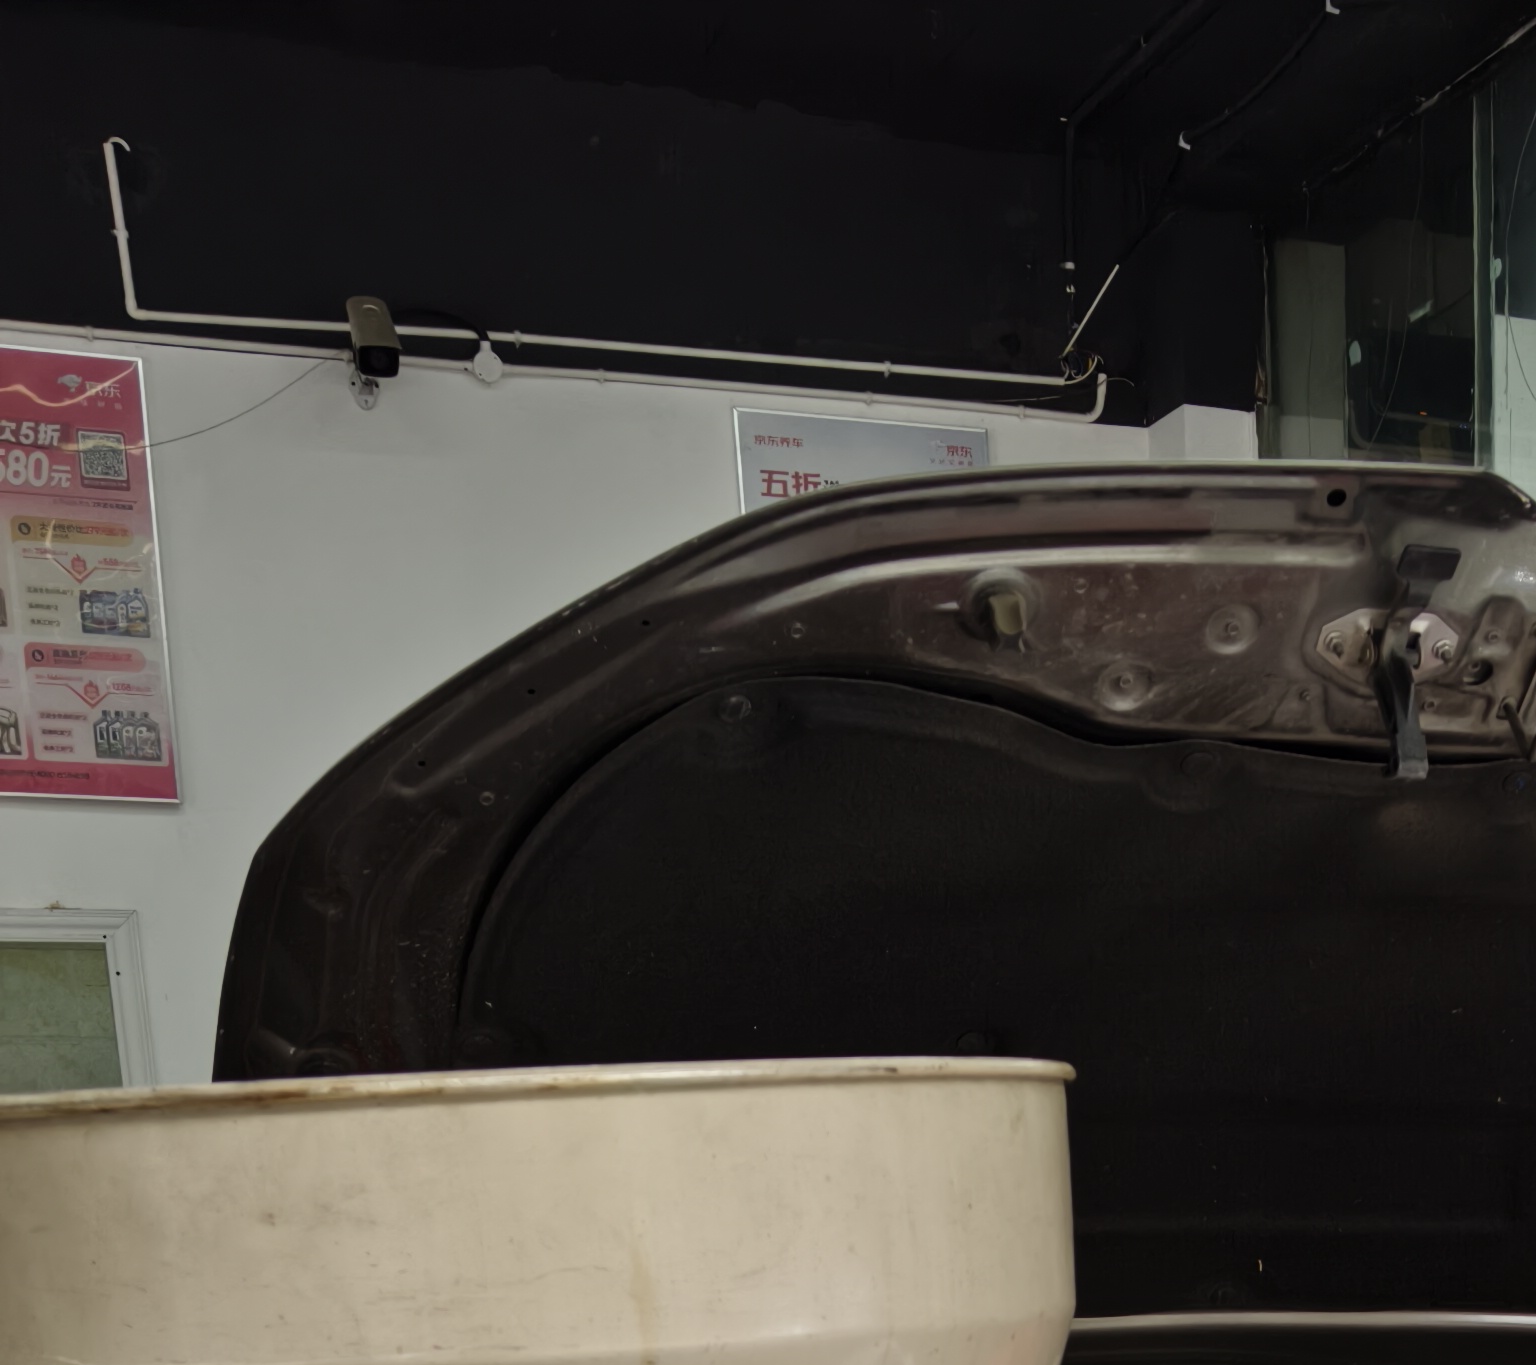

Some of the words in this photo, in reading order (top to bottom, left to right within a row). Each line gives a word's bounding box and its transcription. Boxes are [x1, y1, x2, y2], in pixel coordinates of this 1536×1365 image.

[754, 434, 803, 449] 京东养车
[946, 445, 972, 458] 京东
[760, 469, 821, 498] 五折
